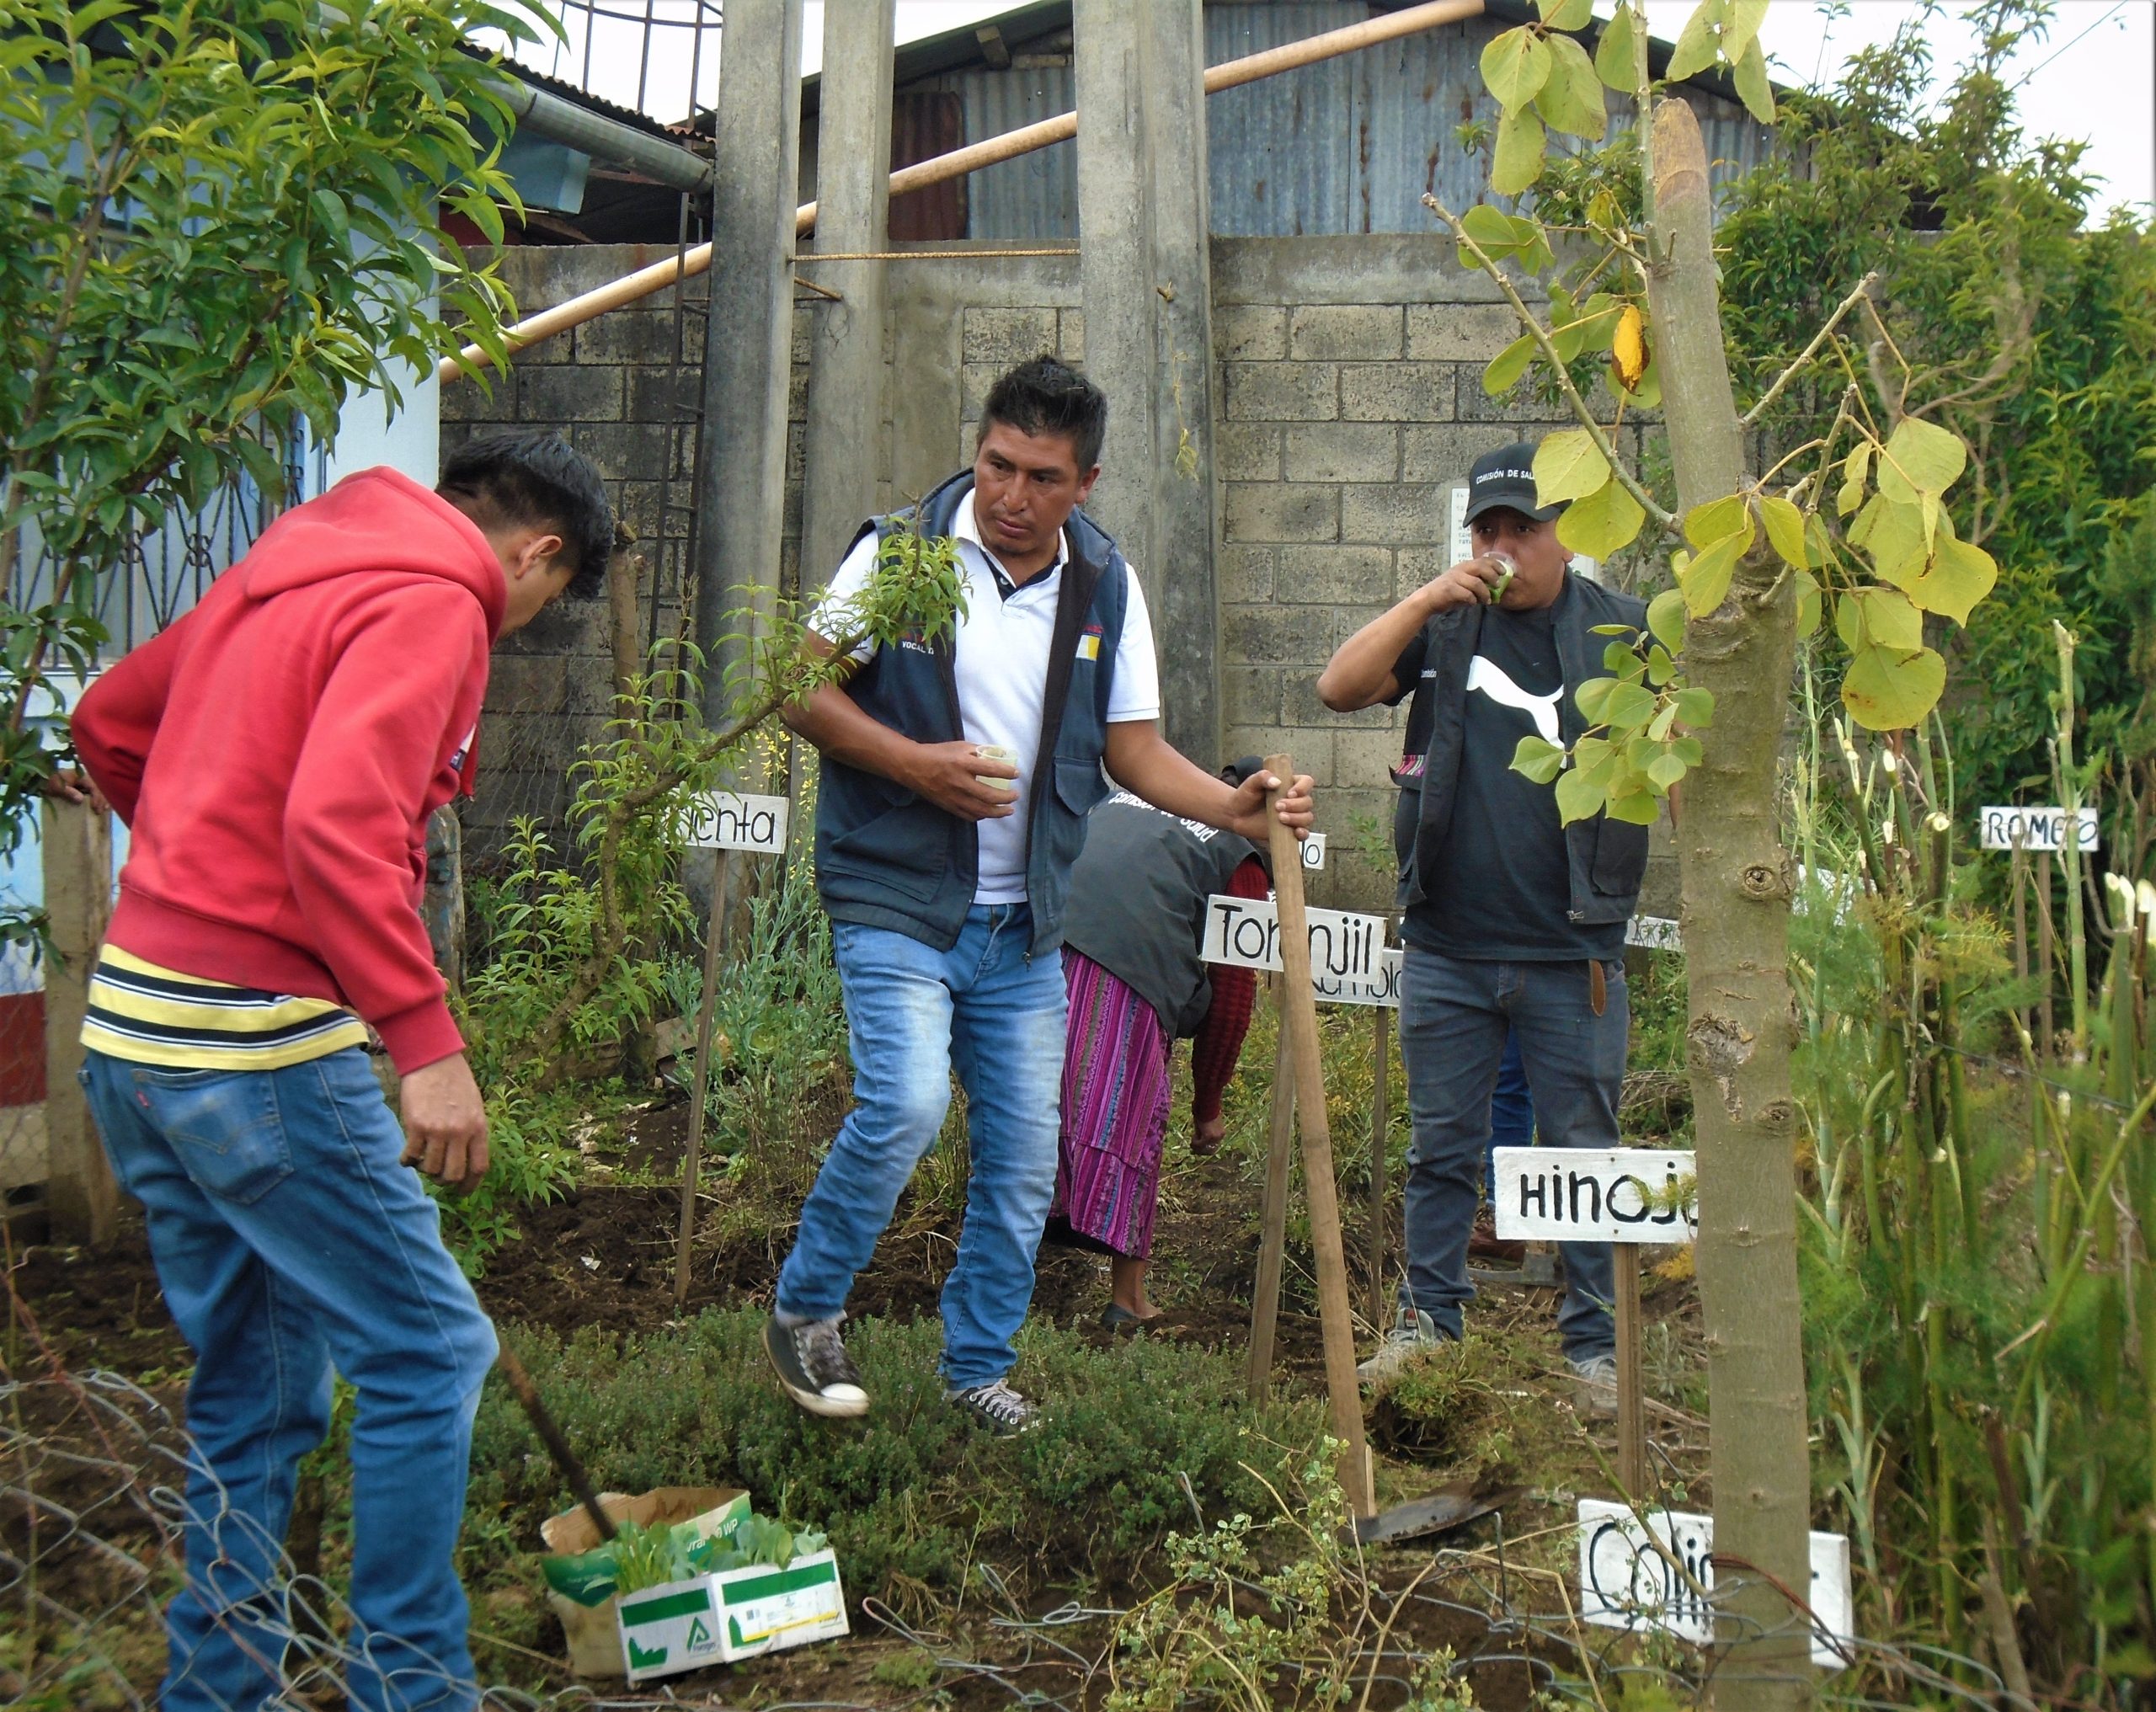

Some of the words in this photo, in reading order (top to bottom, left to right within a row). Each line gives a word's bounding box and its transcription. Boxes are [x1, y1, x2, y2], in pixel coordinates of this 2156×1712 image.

[1508, 469, 1518, 477] DE
[1520, 470, 1535, 480] SAL
[902, 641, 926, 653] VOCAL
[1988, 812, 2098, 845] ROMEO
[1214, 903, 1373, 975] Tornjil
[723, 1518, 738, 1536] WP
